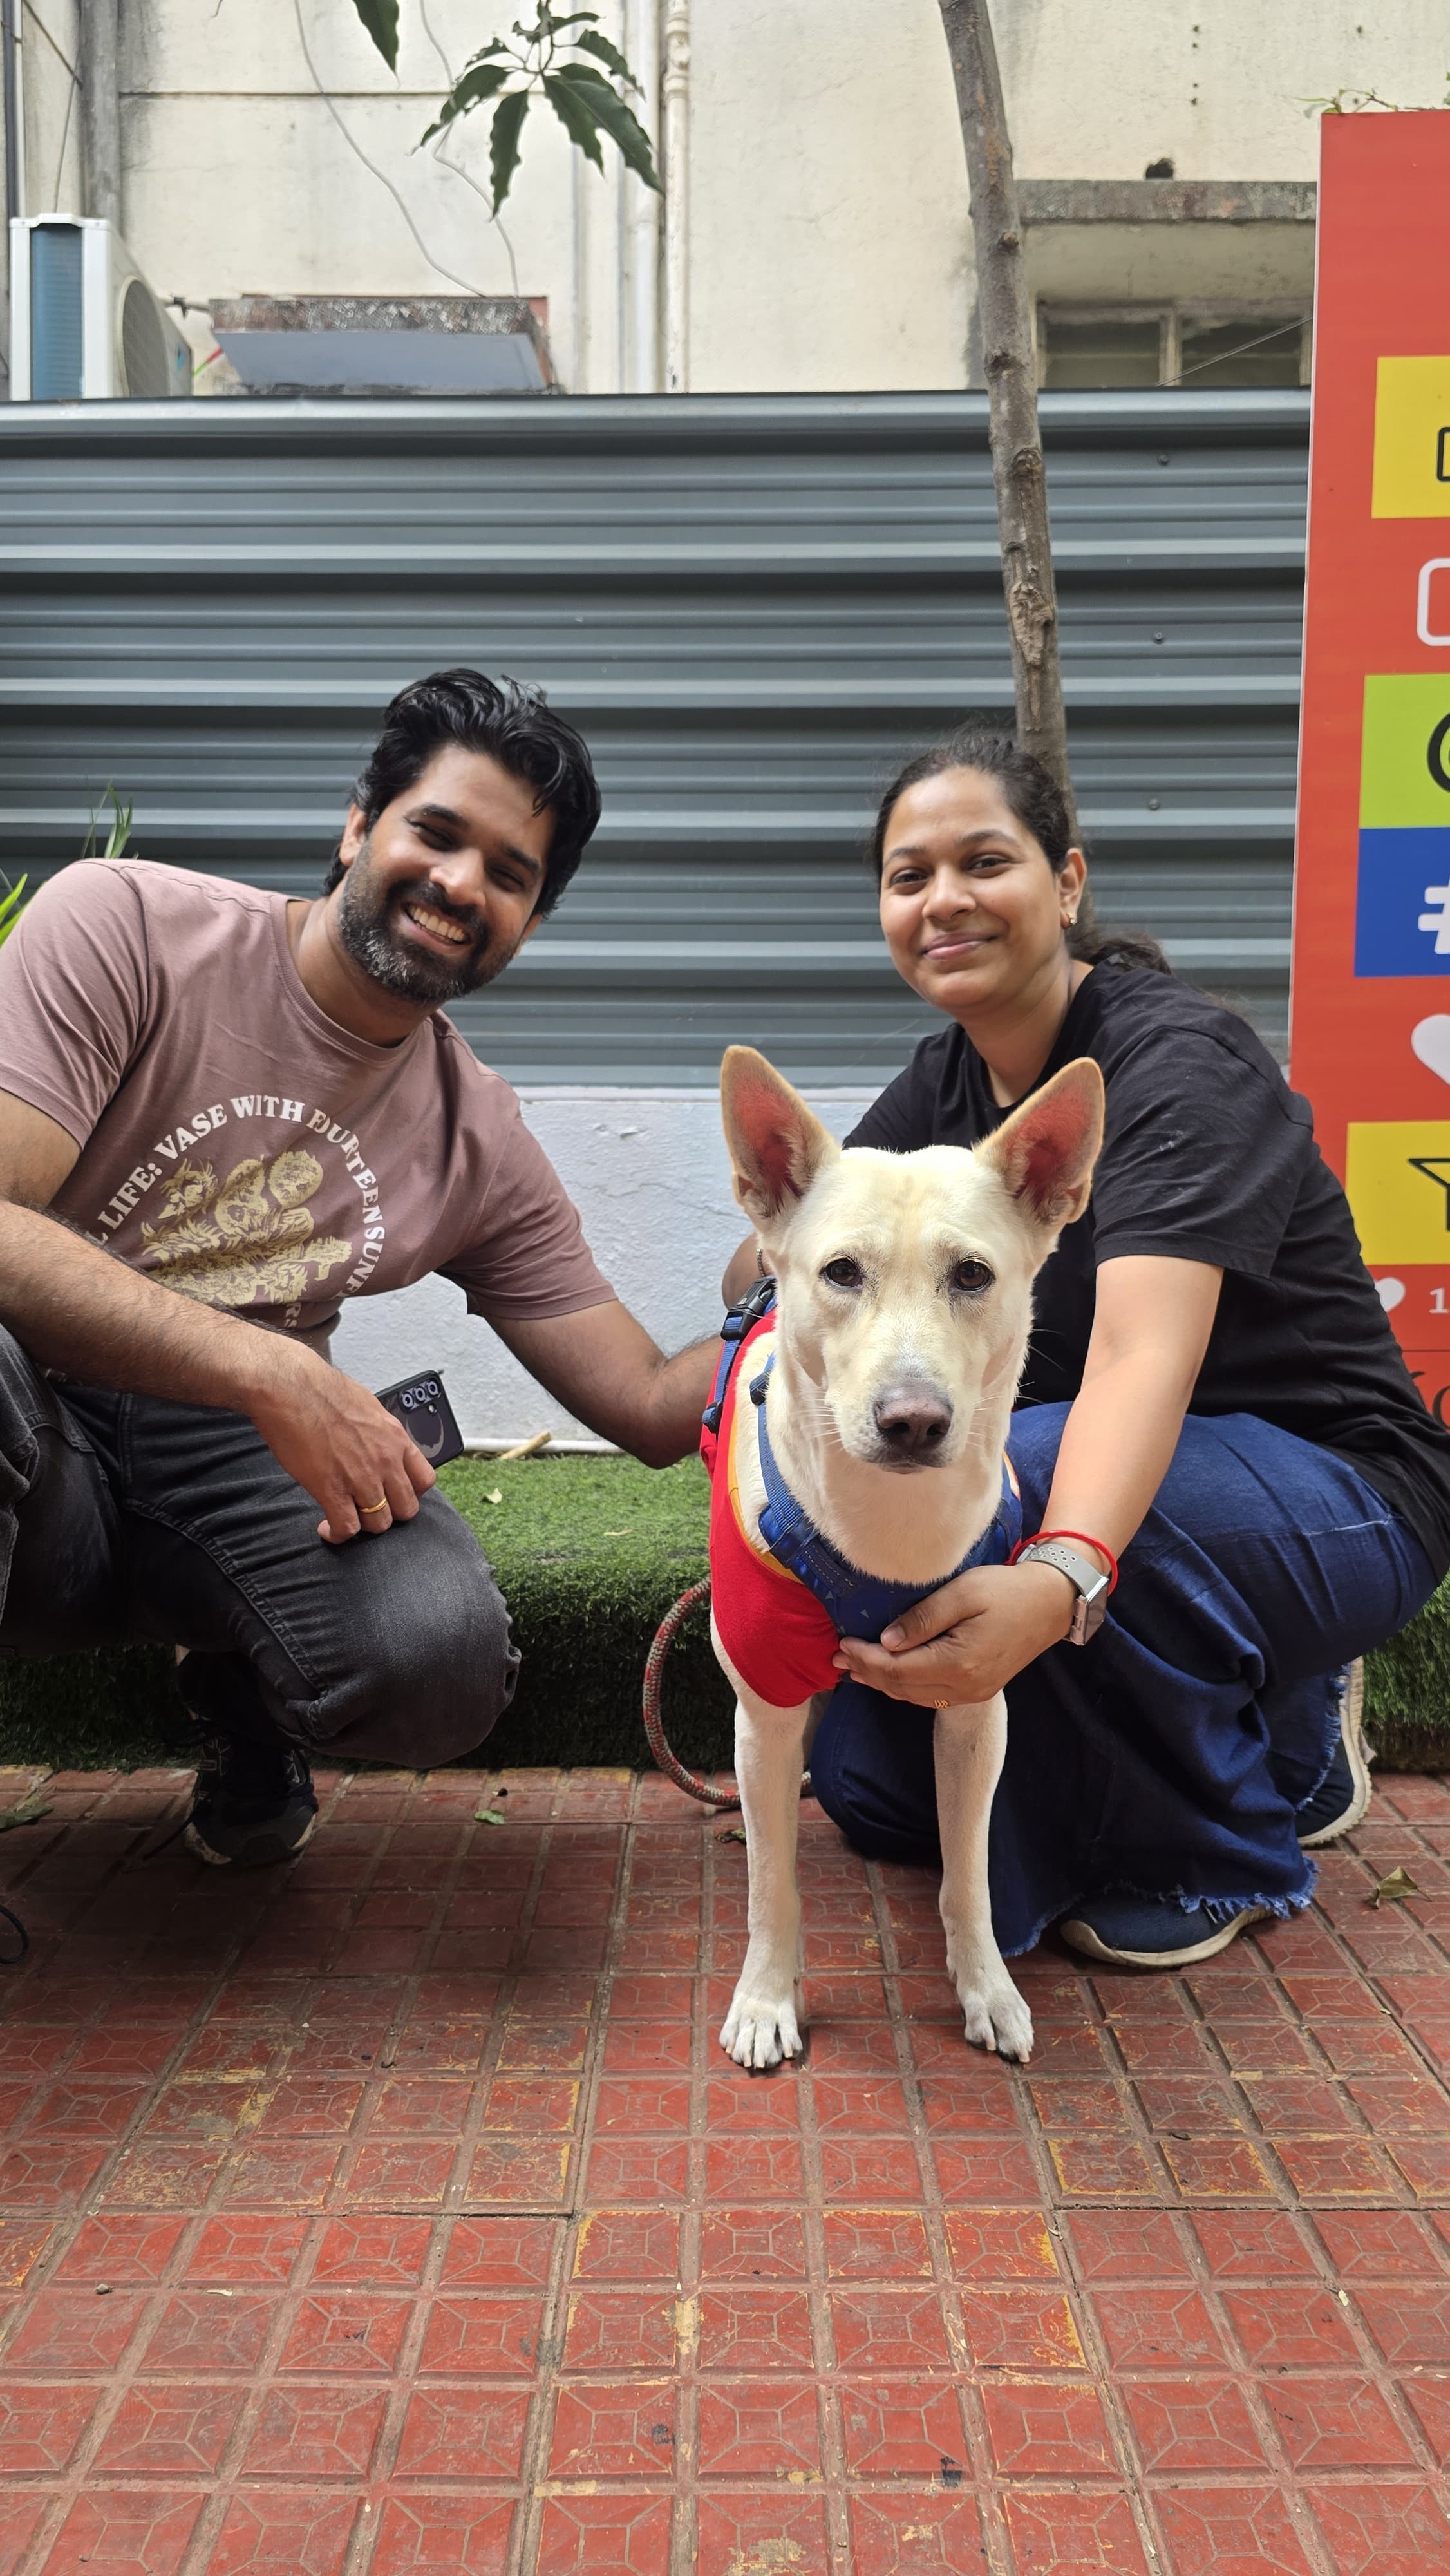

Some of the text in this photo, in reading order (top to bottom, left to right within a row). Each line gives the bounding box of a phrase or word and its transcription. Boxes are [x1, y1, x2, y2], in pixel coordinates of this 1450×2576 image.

[97, 1162, 163, 1230] LIFE:
[153, 1103, 227, 1160] VASE
[230, 1095, 306, 1123] WITH
